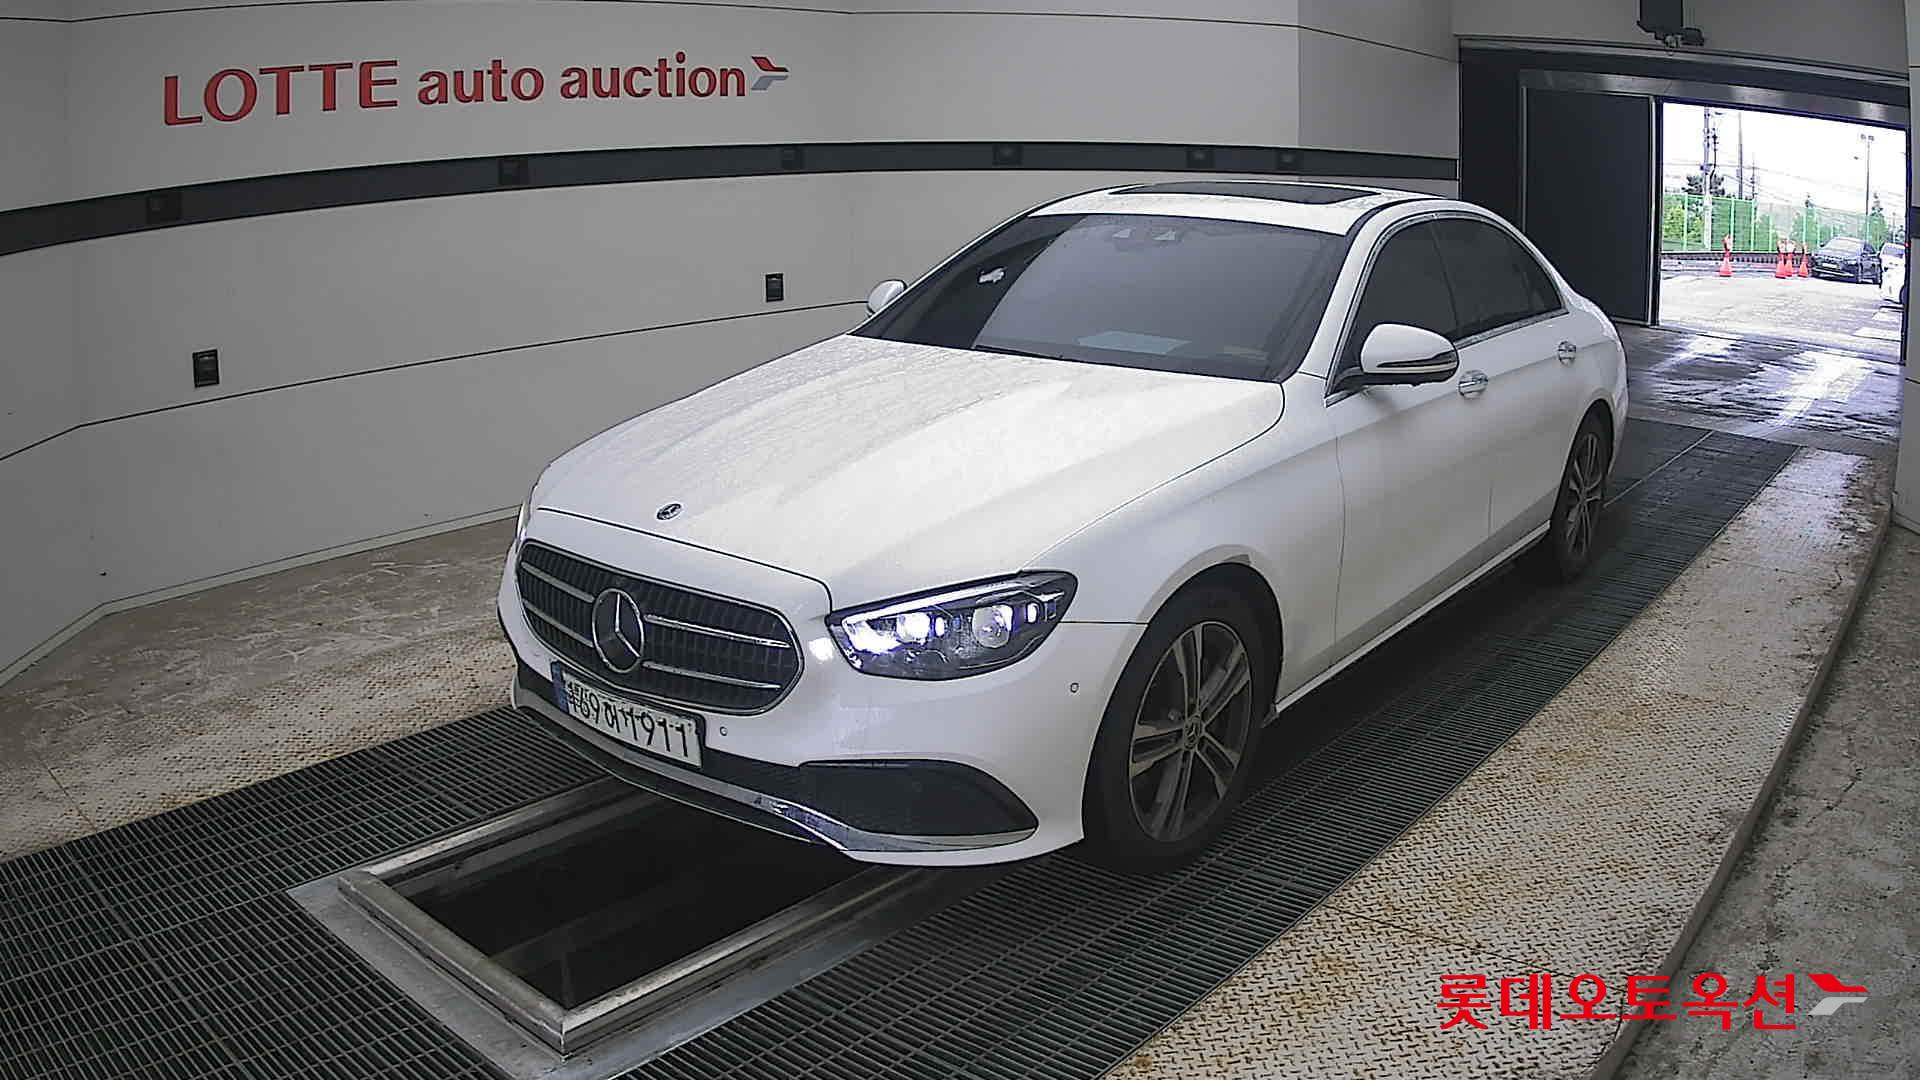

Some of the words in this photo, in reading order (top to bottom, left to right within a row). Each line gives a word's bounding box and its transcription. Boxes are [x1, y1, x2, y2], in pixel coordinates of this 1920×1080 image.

[164, 59, 399, 126] LOTTE
[417, 58, 545, 105] auto
[560, 51, 747, 100] auction
